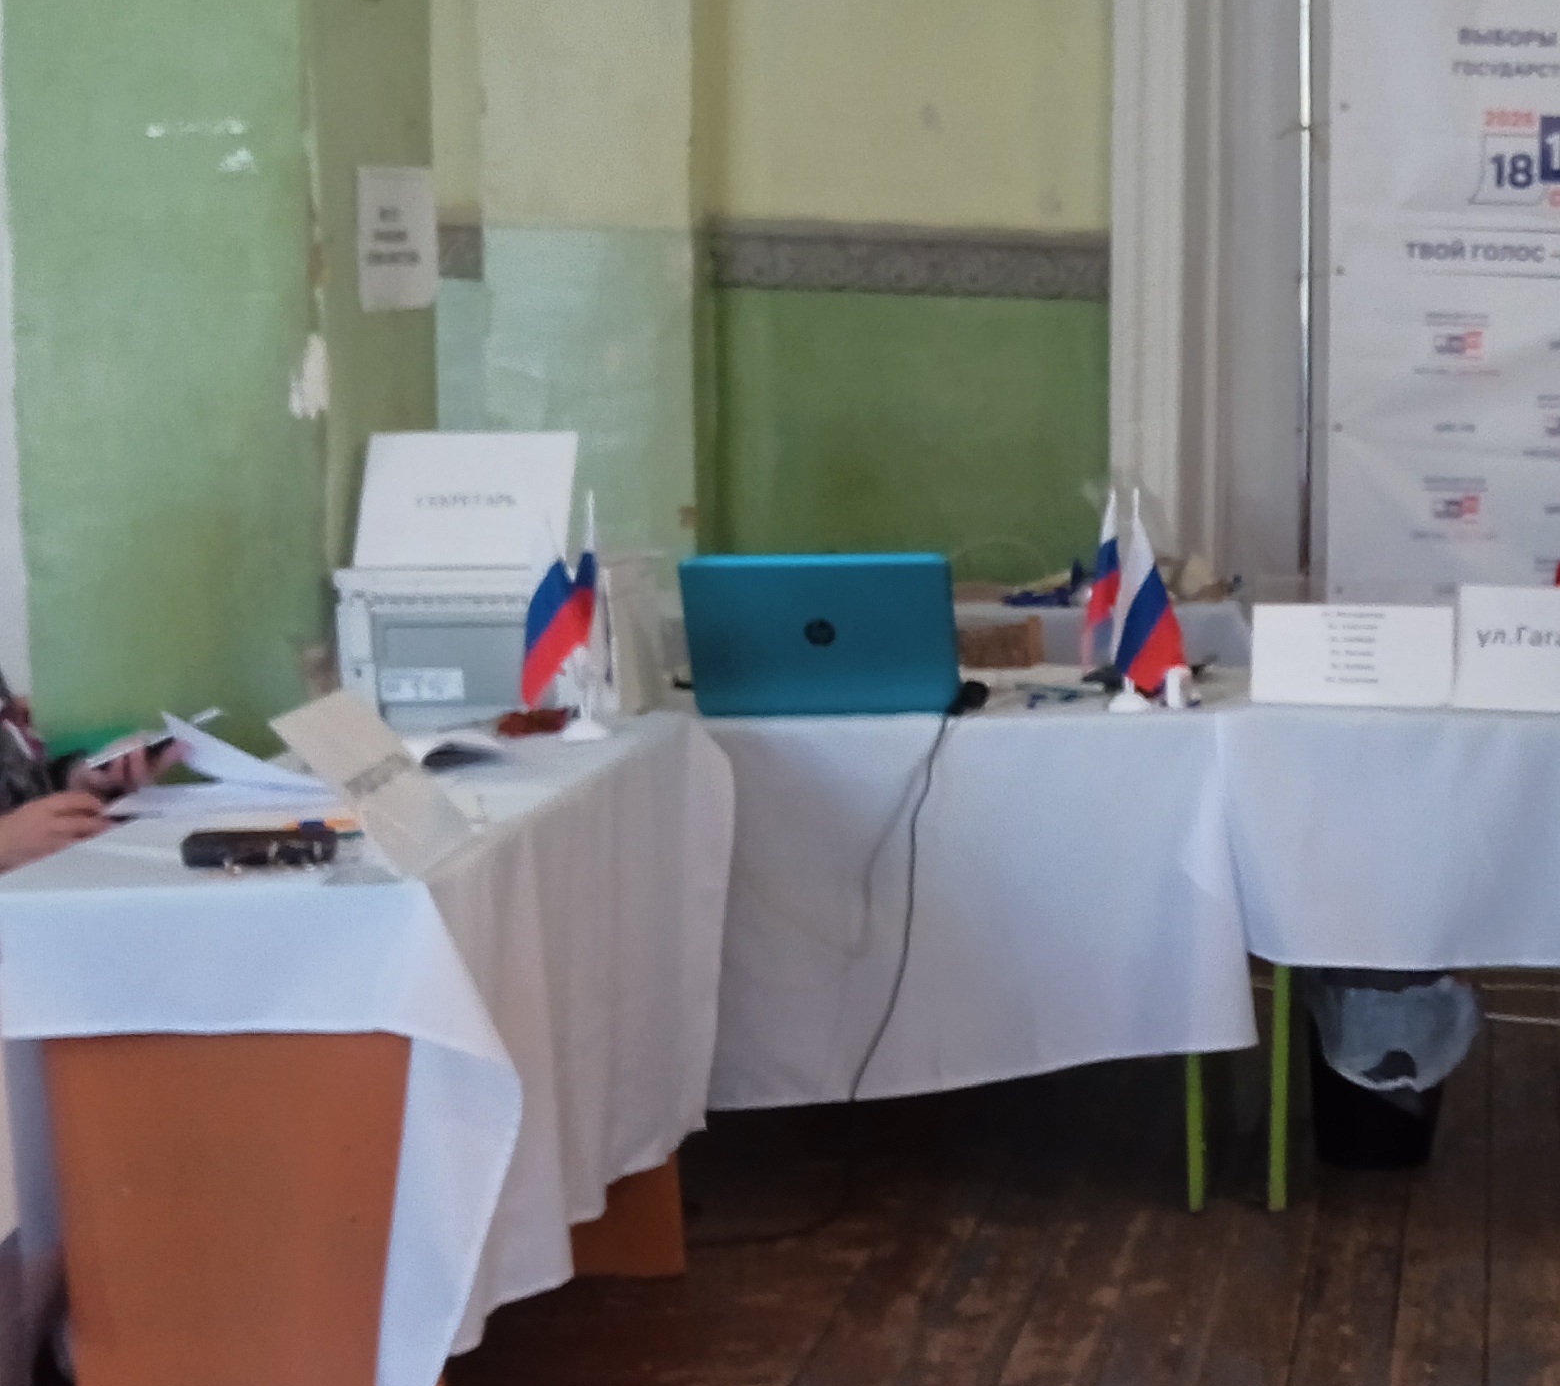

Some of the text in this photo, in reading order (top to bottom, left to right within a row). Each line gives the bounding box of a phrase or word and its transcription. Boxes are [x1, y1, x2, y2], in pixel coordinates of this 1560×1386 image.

[1458, 27, 1557, 47] ВЫБОРЫ
[1490, 153, 1534, 188] 18
[1406, 240, 1466, 261] ТВОЙ
[1471, 243, 1545, 263] ГОЛОС
